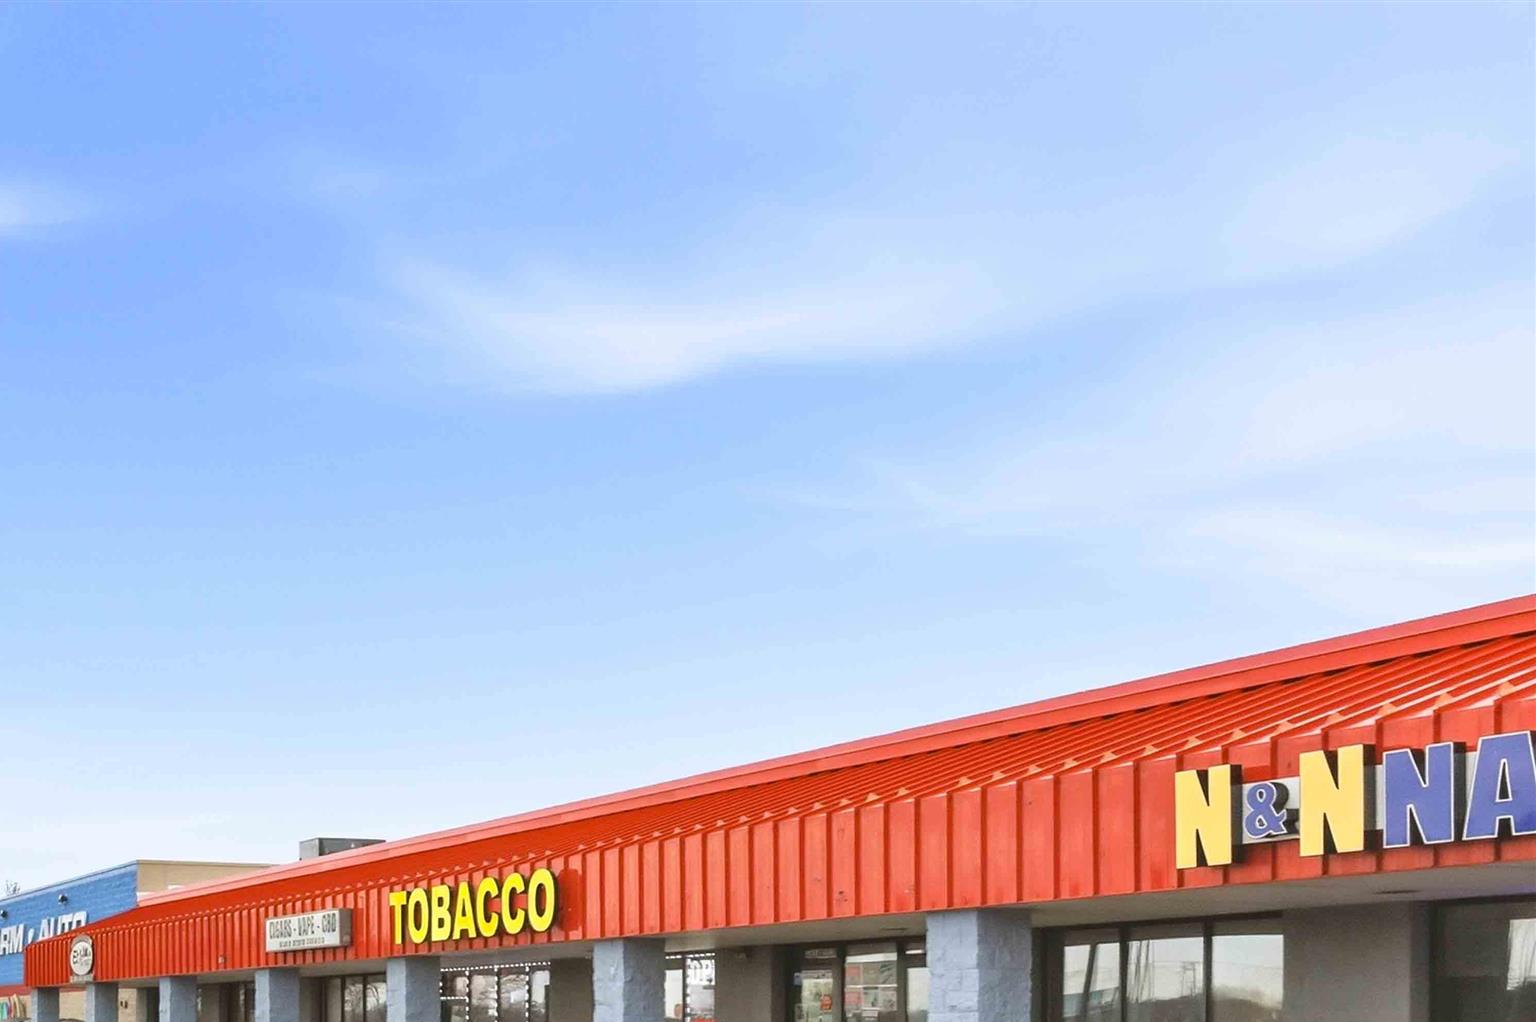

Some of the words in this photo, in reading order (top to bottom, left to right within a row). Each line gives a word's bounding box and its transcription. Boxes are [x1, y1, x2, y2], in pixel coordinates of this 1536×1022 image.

[269, 919, 292, 939] CIGARS
[297, 916, 315, 936] VAPE
[389, 868, 555, 945] TOBACCO
